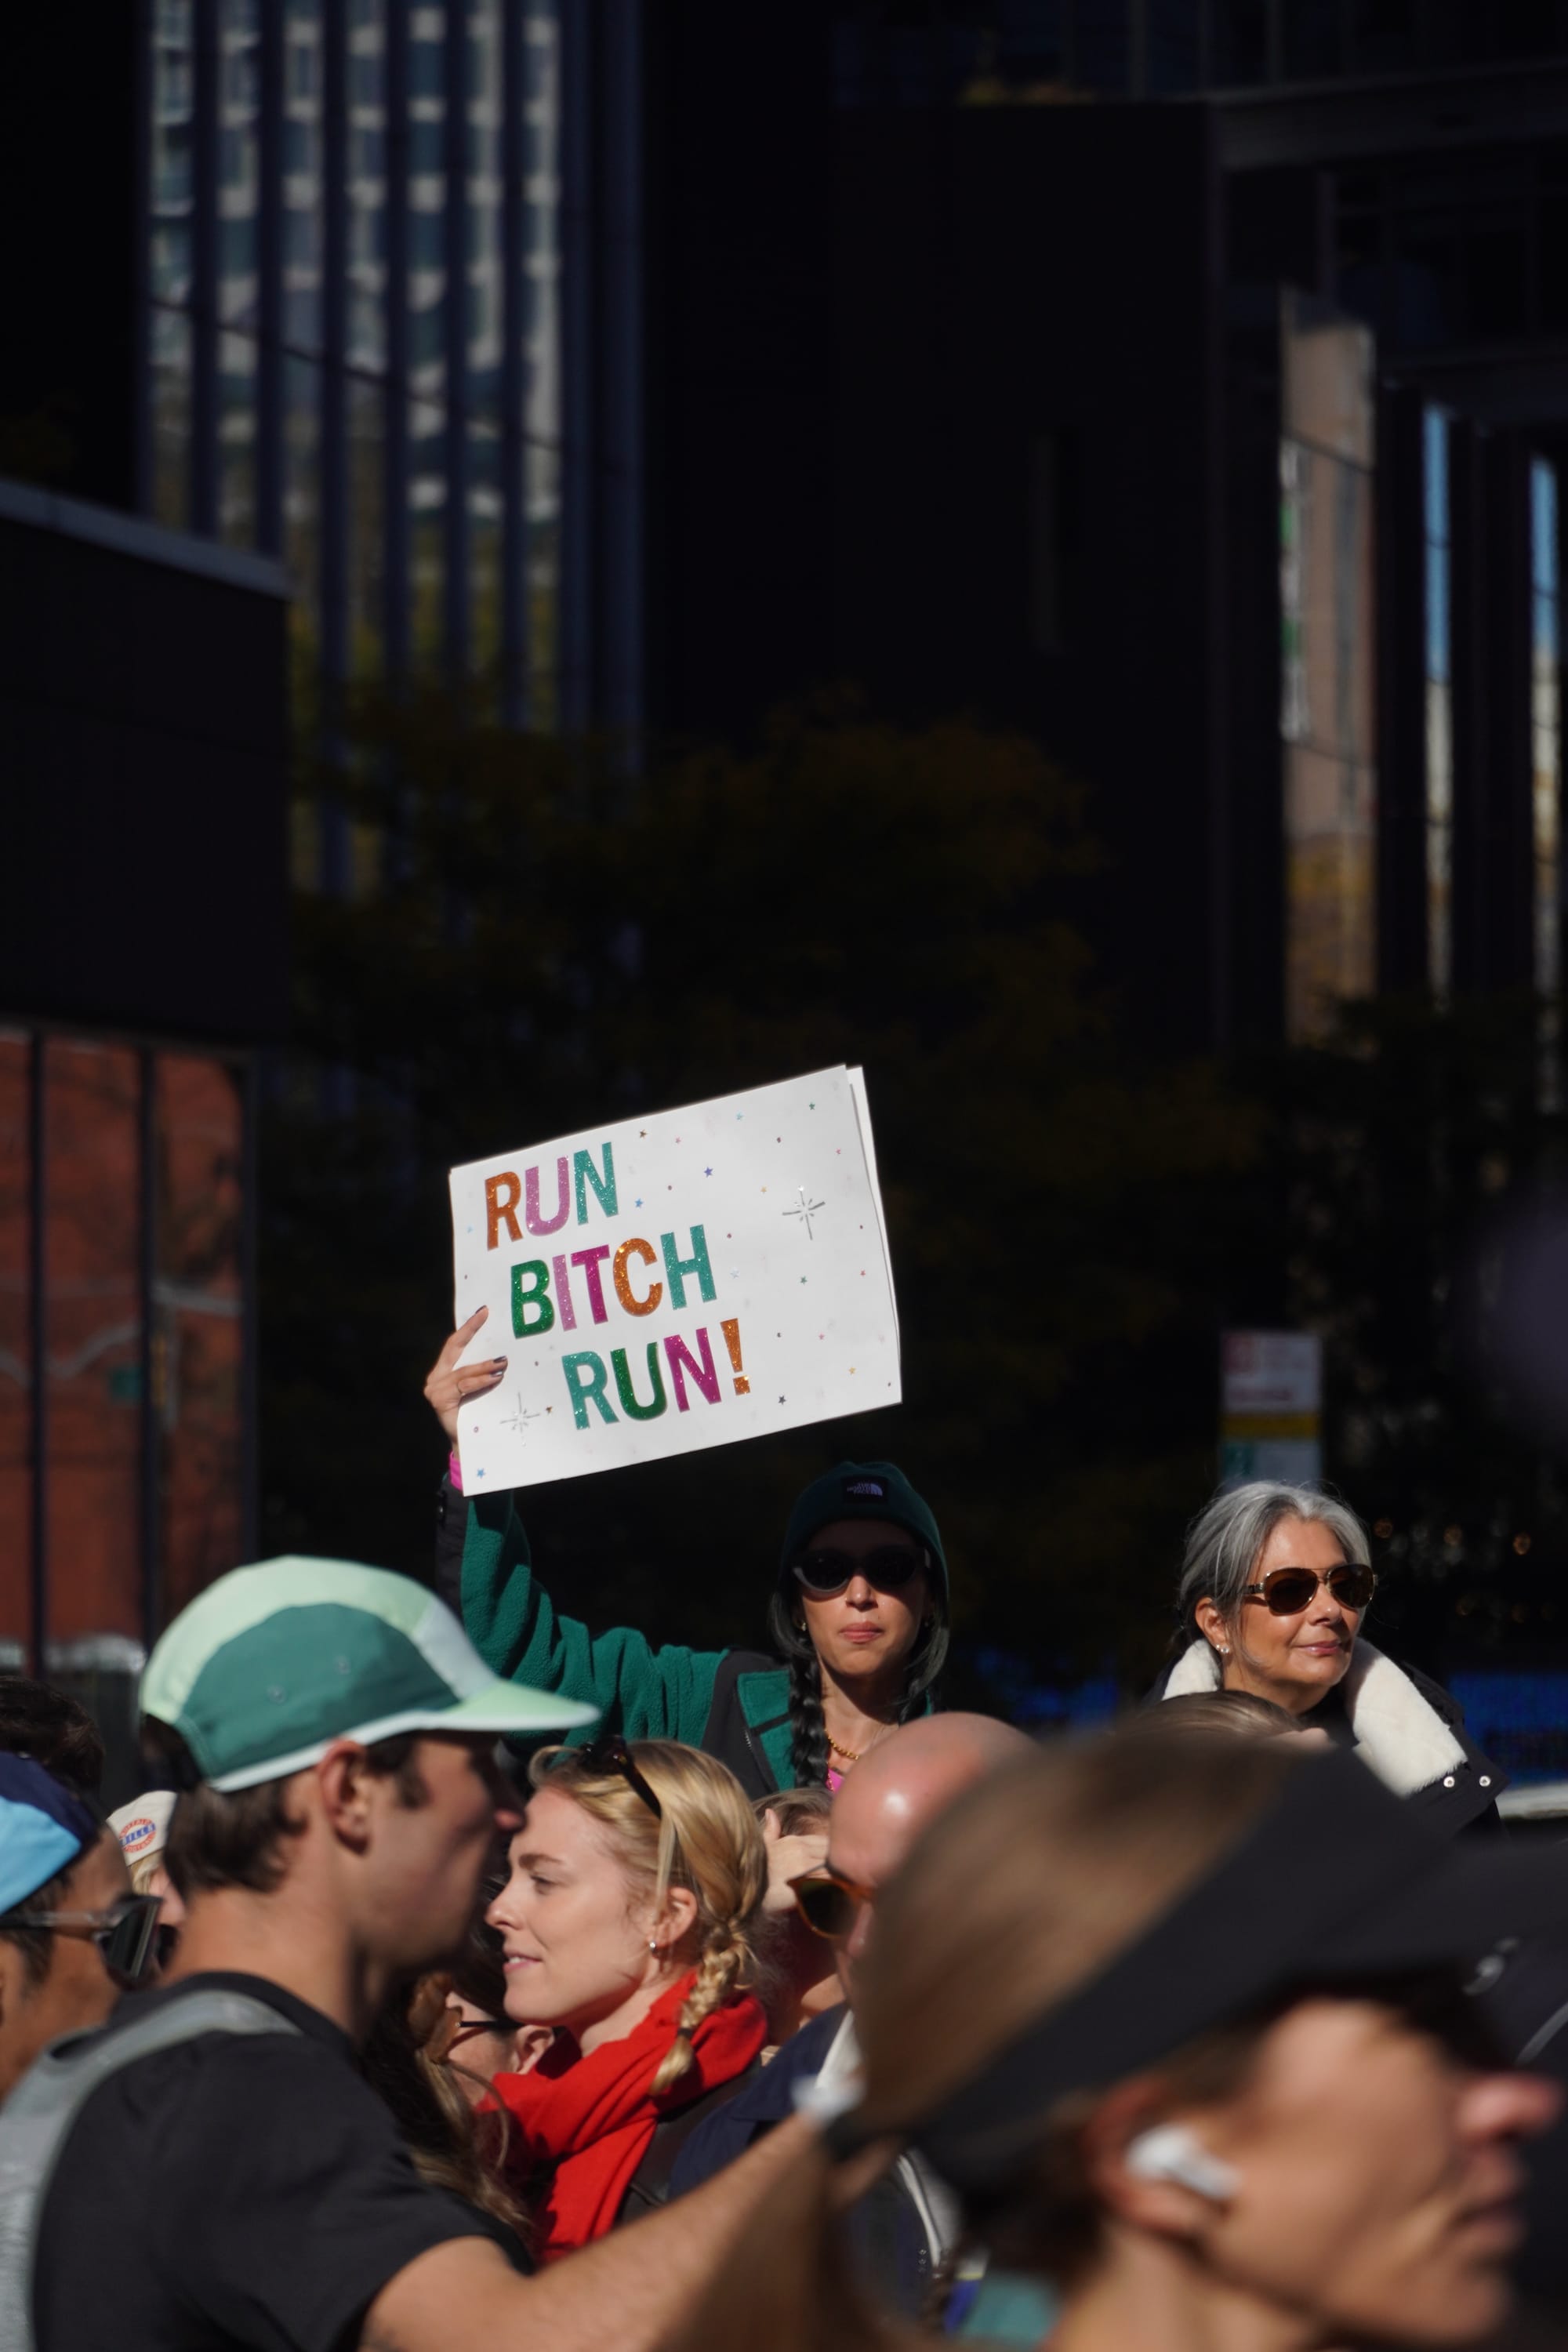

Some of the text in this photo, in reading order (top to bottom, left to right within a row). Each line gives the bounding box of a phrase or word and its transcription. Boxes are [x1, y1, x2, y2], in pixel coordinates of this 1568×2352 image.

[485, 1142, 619, 1250] RUN
[510, 1224, 717, 1339] BITCH
[561, 1318, 750, 1430] RUN!
